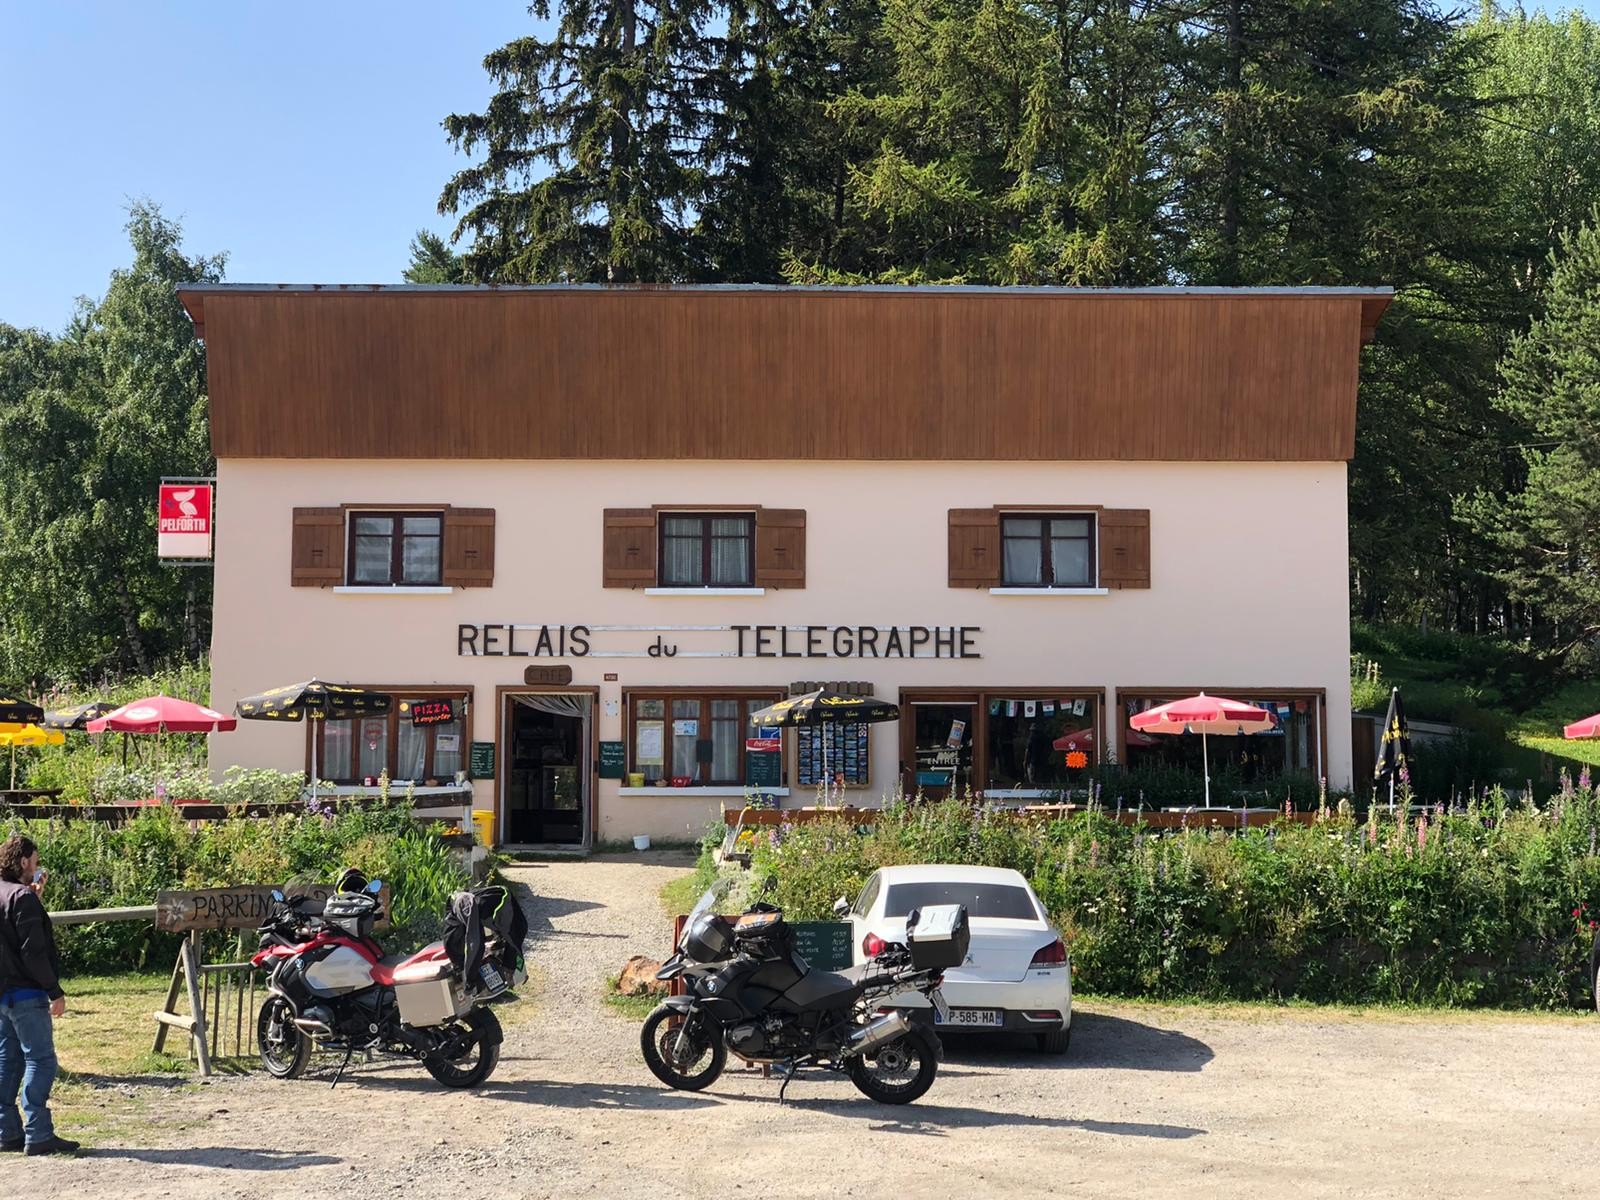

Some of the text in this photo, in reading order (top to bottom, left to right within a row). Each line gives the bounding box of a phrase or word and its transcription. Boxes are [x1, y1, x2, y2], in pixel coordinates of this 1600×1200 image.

[161, 518, 206, 531] PELFORTH
[458, 624, 981, 658] RELAIS du TELEGRAPHE
[414, 703, 449, 715] PIZZA
[192, 890, 276, 920] PARKIN
[942, 1011, 995, 1024] P-585-HA
